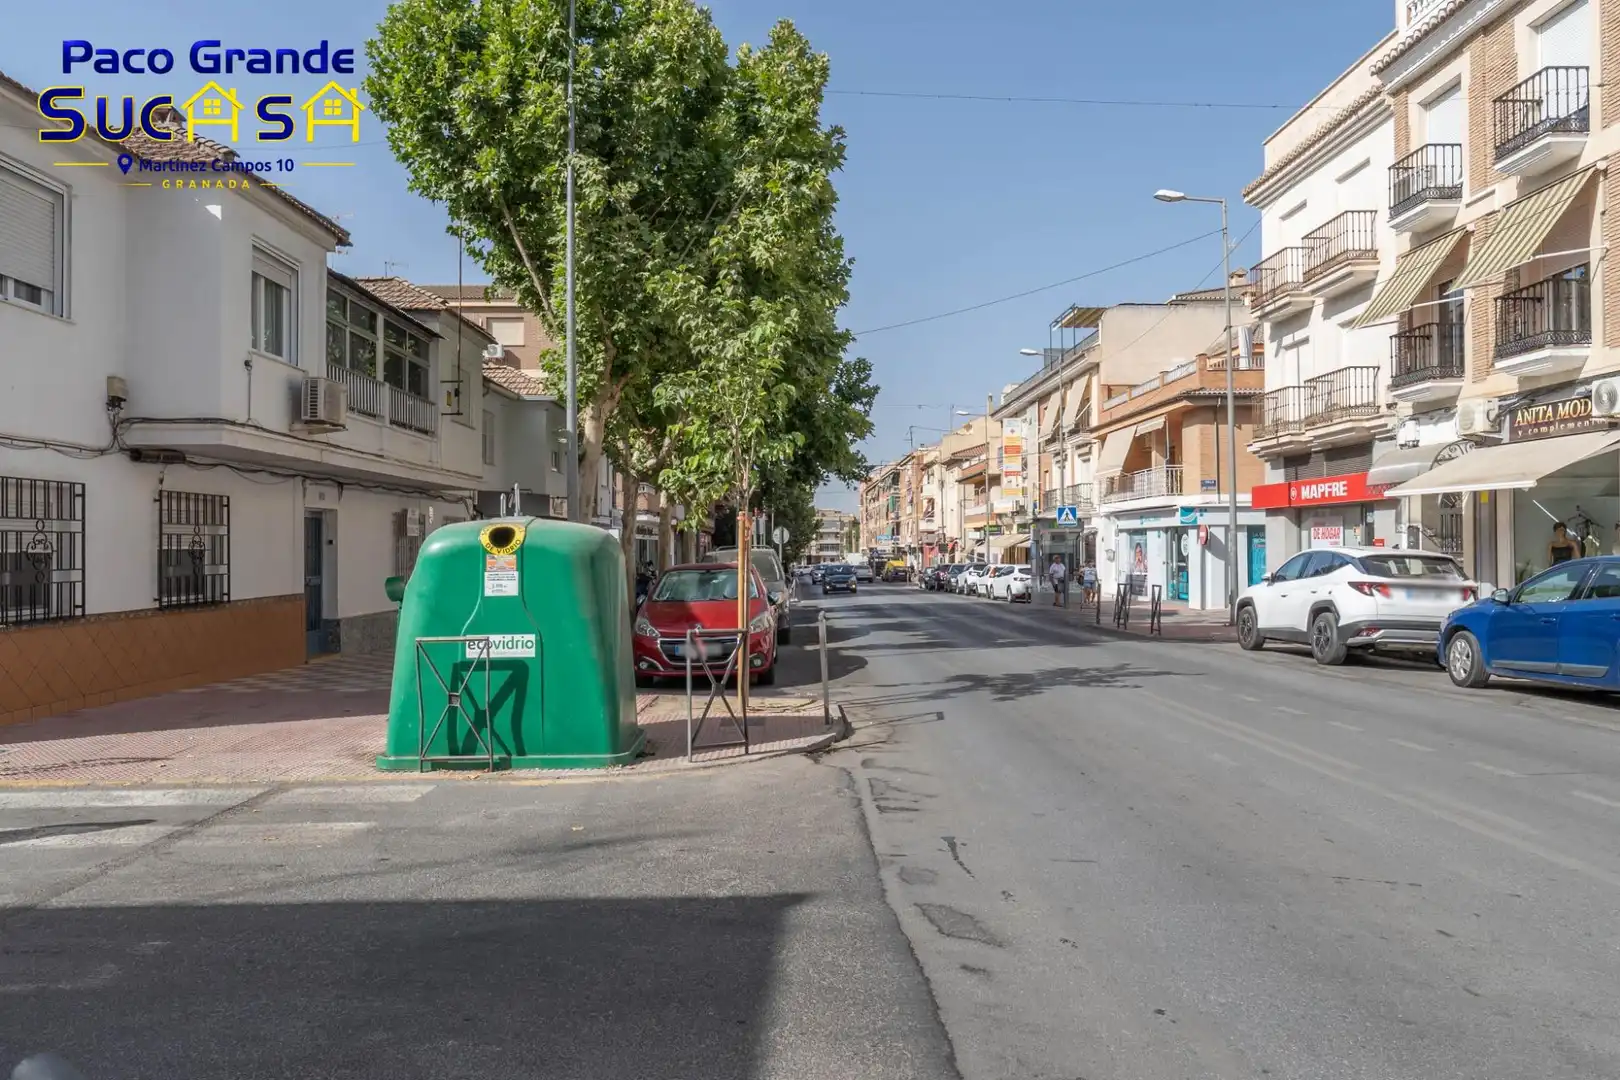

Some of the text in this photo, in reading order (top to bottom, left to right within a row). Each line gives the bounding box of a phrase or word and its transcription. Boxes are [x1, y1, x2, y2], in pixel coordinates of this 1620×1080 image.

[1514, 398, 1593, 426] ANITA MOD
[1301, 481, 1348, 499] MAPFRE
[496, 539, 522, 555] VIDRIO
[467, 635, 534, 650] ecovidrio
